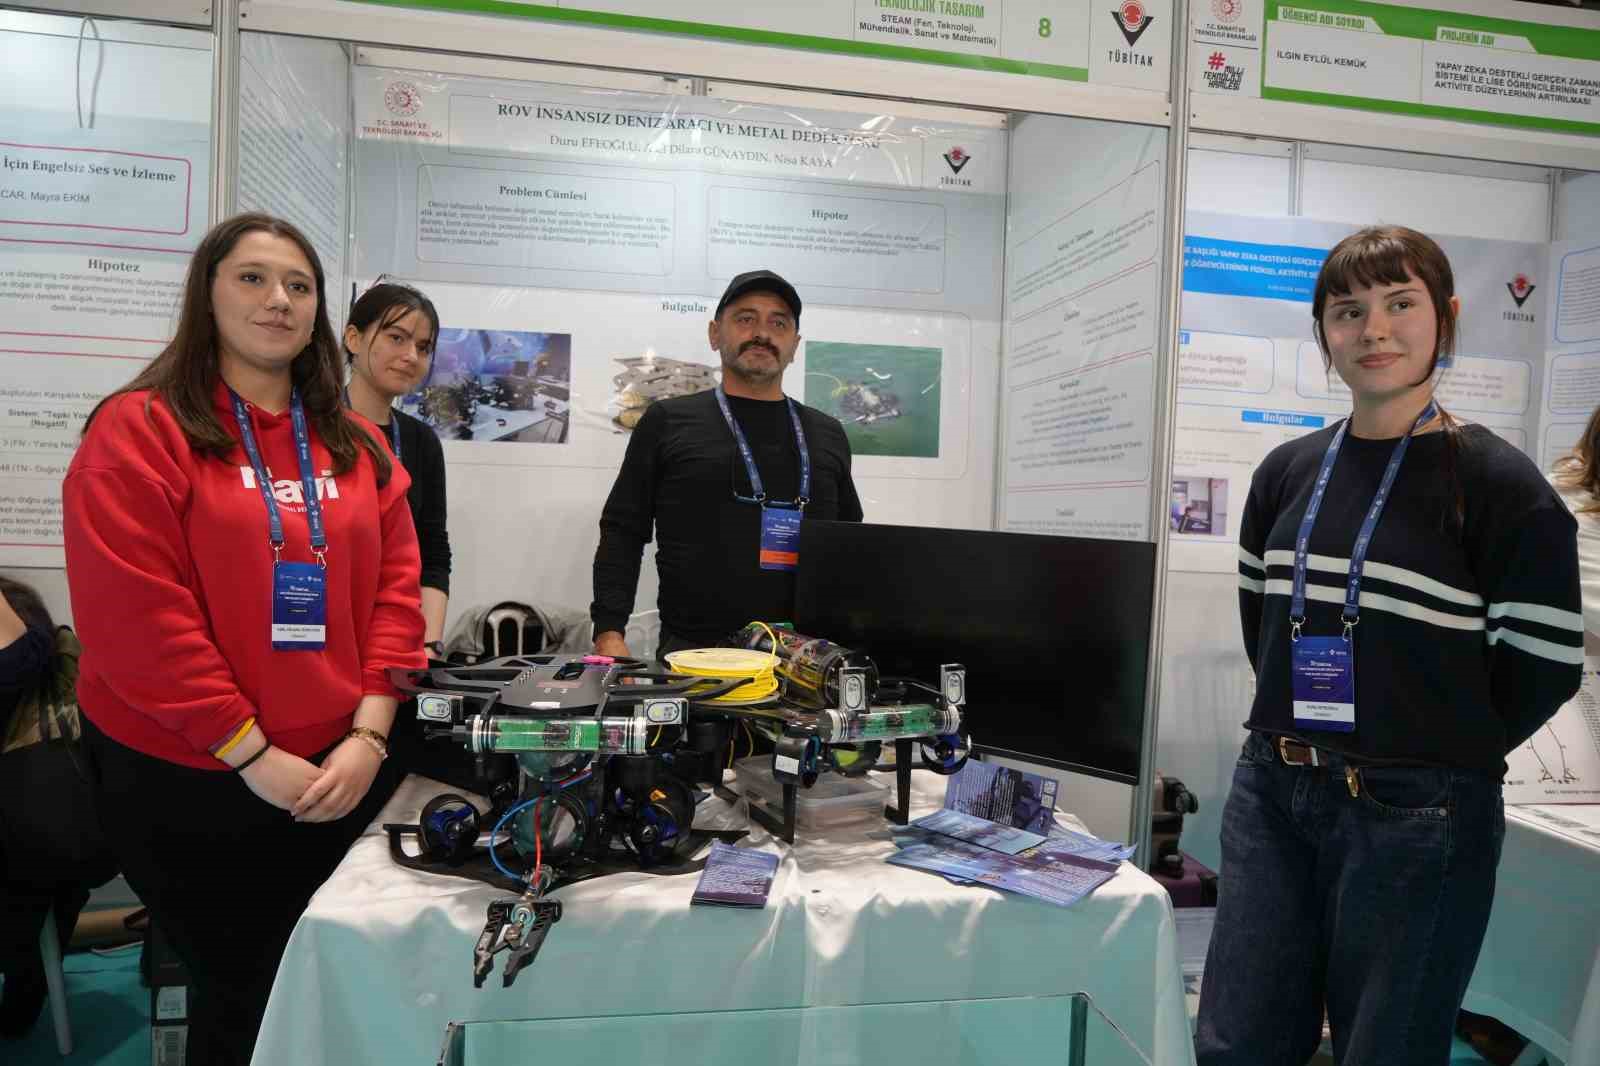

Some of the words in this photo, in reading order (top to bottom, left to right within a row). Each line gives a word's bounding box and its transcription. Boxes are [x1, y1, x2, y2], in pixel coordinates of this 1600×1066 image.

[939, 2, 985, 18] TASARIM
[881, 14, 912, 25] STEAM
[1038, 17, 1052, 38] 8
[914, 28, 939, 39] Sanat
[940, 32, 950, 40] ve
[1108, 49, 1154, 67] TÜBİTAK
[1303, 53, 1332, 65] EYLÜL
[1334, 57, 1367, 69] KEMÜK
[1435, 61, 1462, 72] YAPAY
[1464, 64, 1487, 75] ZEKA
[1488, 68, 1530, 79] DESTEKLİ
[1532, 73, 1567, 84] GERÇEK
[1435, 70, 1469, 81] SİSTEMİ
[1486, 76, 1505, 87] LİSE
[1434, 81, 1473, 92] AKTİVİTE
[1538, 93, 1592, 105] ARTIRILMASI
[498, 103, 532, 116] ROV
[536, 103, 611, 125] İNSANSIZ
[738, 124, 787, 140] METAL
[550, 135, 578, 147] Duru
[32, 159, 86, 176] Engelsiz
[87, 162, 110, 175] Ses
[112, 168, 129, 177] ve
[131, 165, 177, 183] İzleme
[499, 185, 543, 198] Problem
[811, 208, 850, 222] Hipotez
[88, 258, 141, 273] Hipotez
